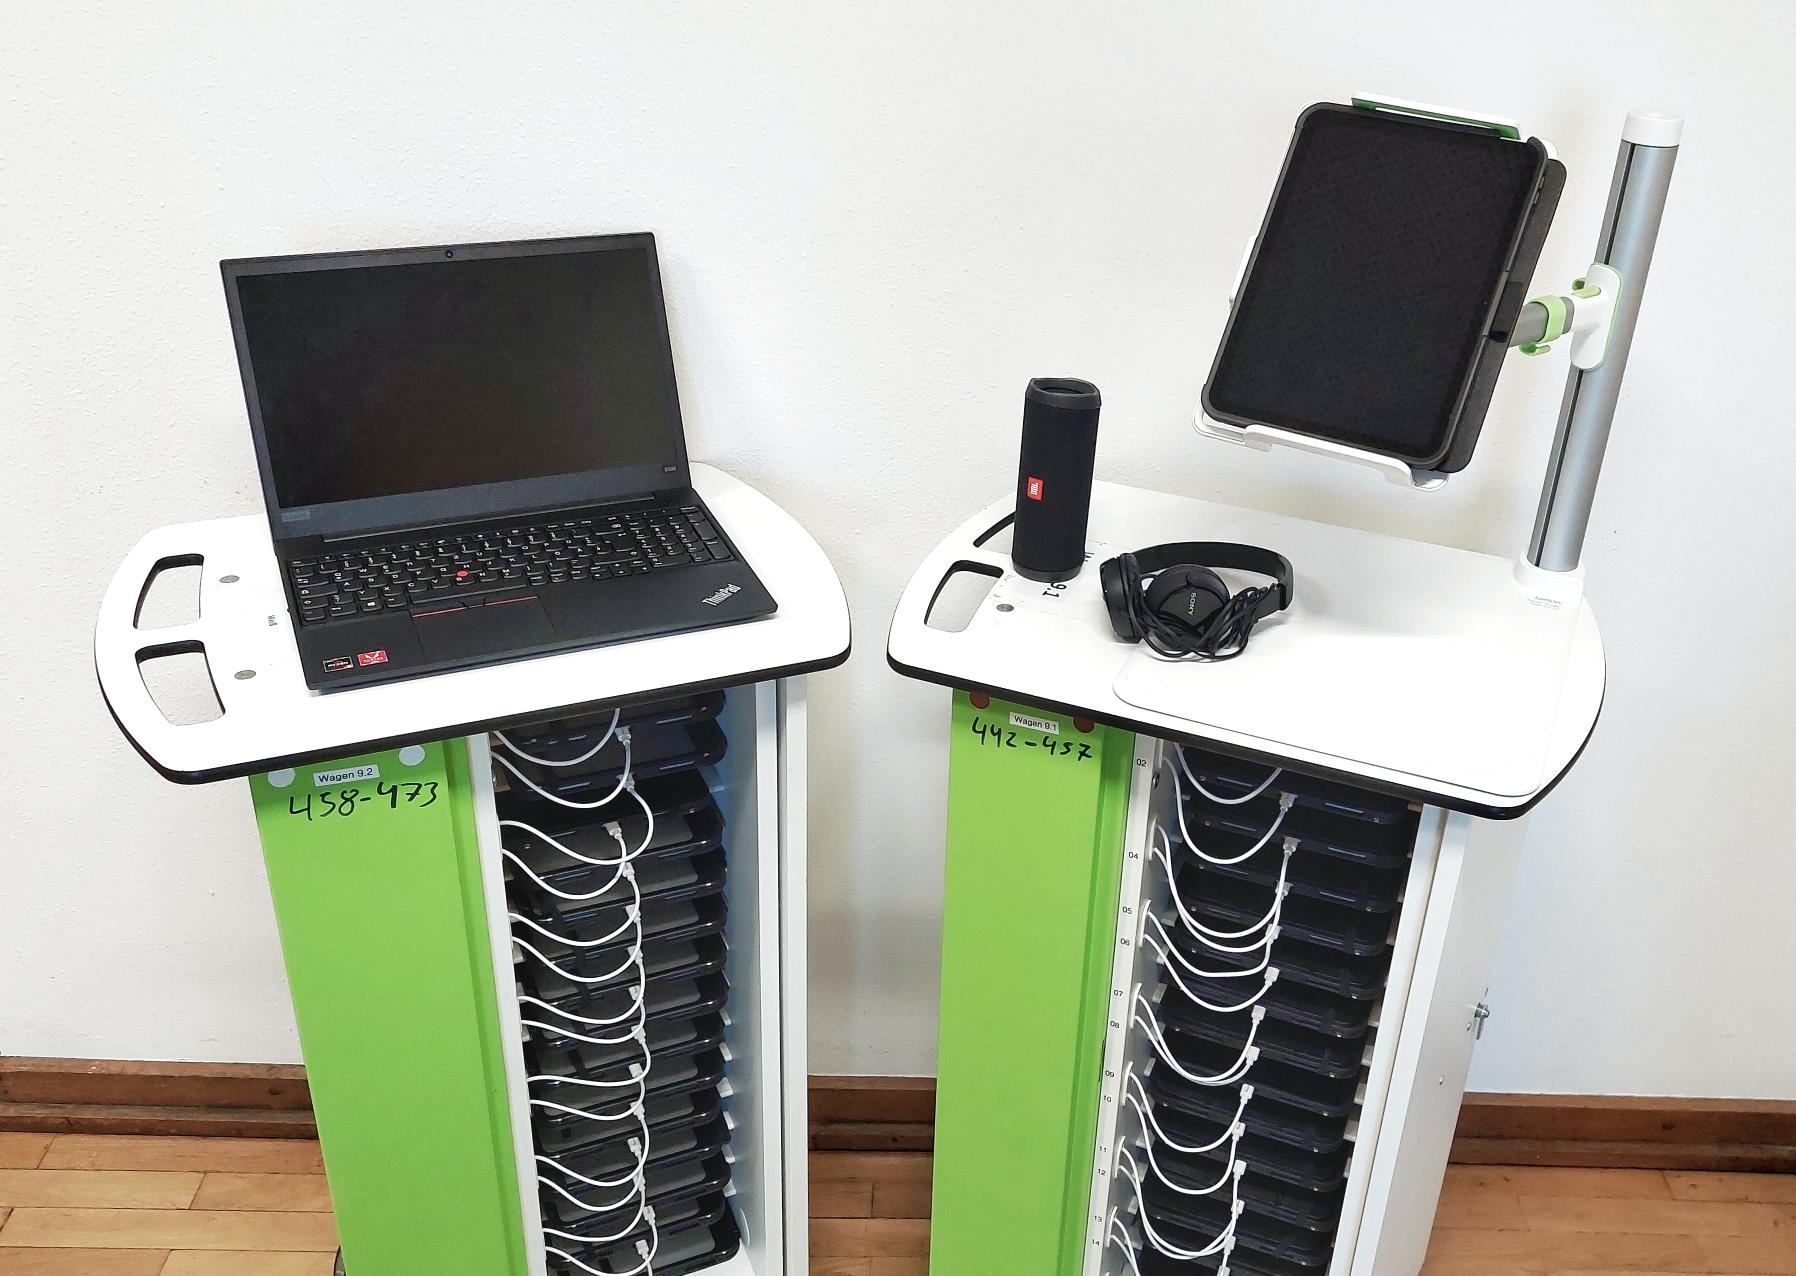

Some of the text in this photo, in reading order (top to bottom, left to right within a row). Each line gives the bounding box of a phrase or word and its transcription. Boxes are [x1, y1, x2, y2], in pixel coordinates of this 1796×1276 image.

[1187, 592, 1197, 616] SONY
[1014, 715, 1057, 732] Wagen 9.1
[1136, 758, 1147, 767] 02
[318, 768, 373, 783] Wagen 9.2
[289, 781, 439, 821] 458-473
[1128, 851, 1139, 859] 04
[1122, 905, 1132, 914] 05
[1120, 938, 1130, 946] 06
[1113, 989, 1123, 997] 07
[1109, 1020, 1120, 1029] 08
[1105, 1070, 1115, 1078] 09
[1103, 1095, 1112, 1103] 10
